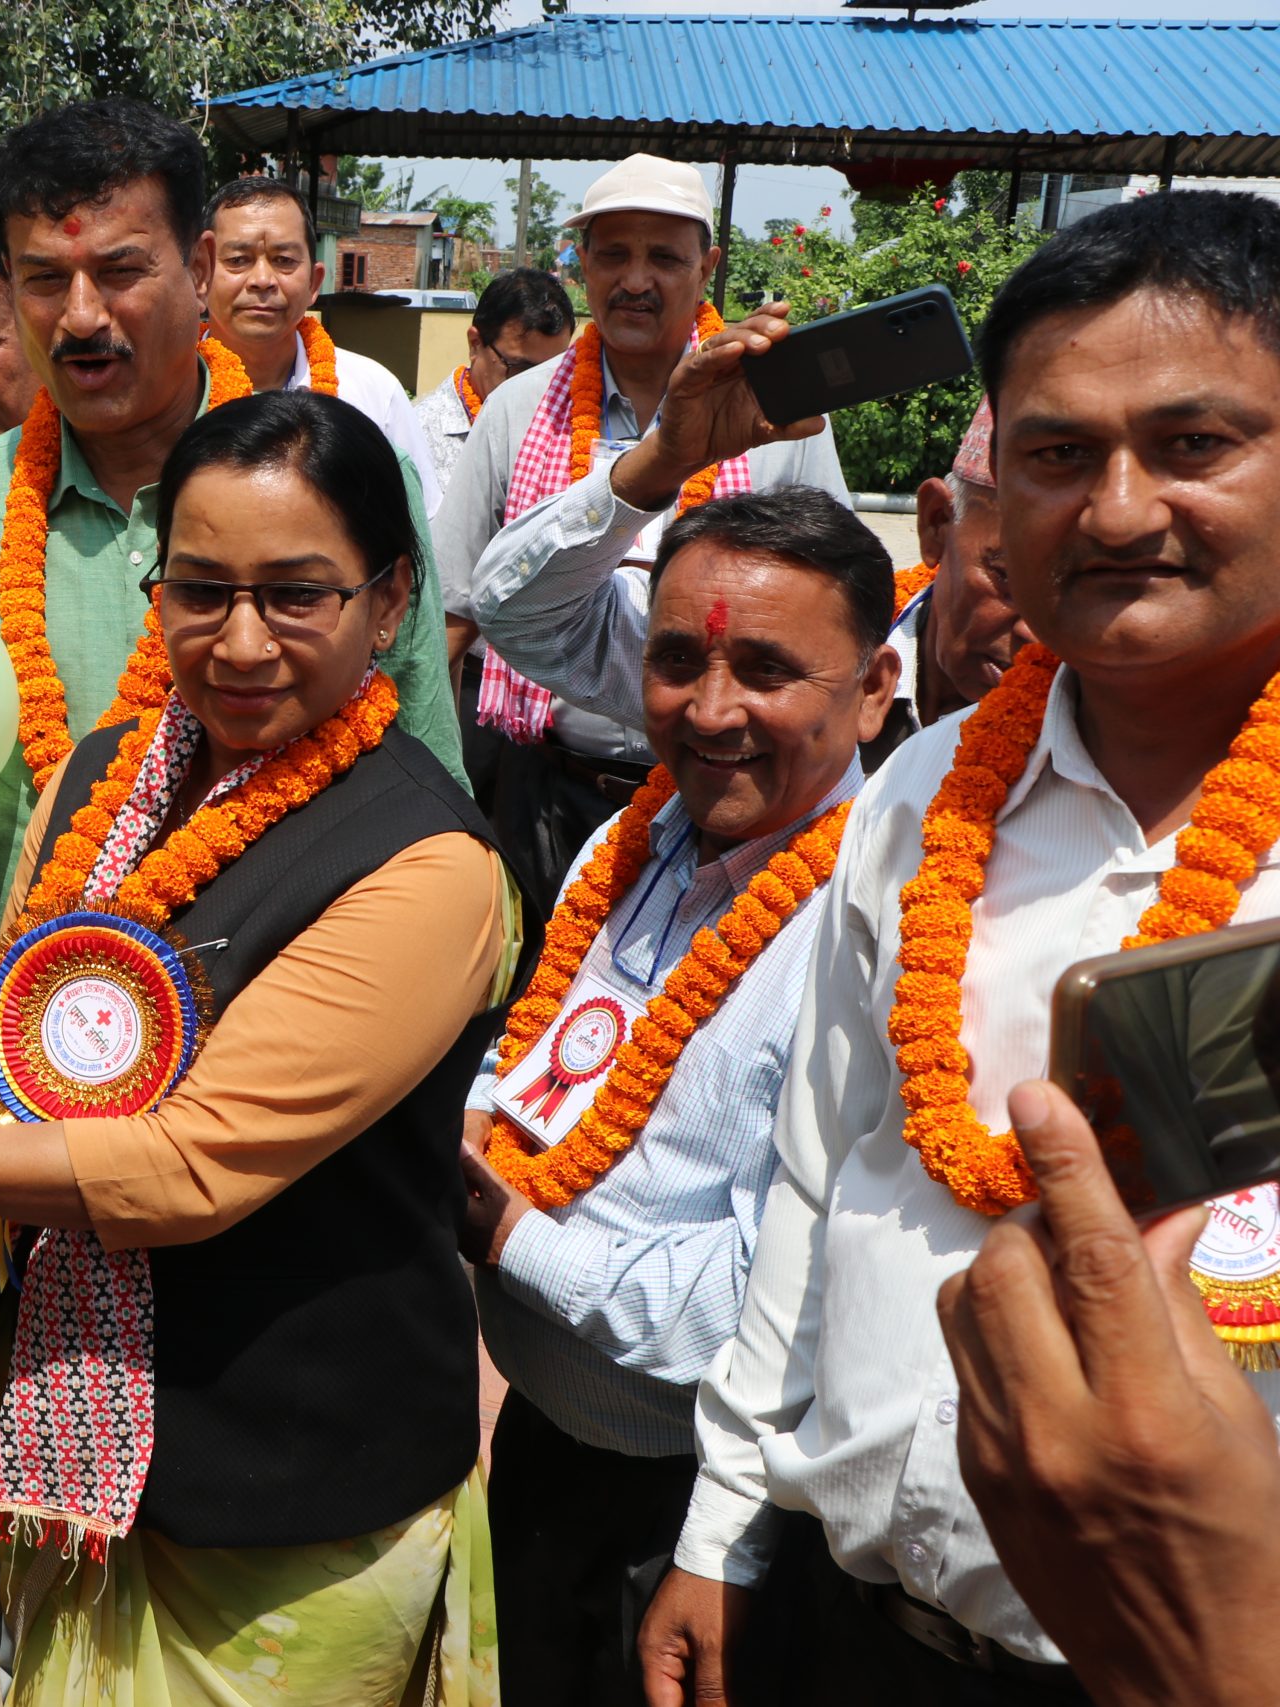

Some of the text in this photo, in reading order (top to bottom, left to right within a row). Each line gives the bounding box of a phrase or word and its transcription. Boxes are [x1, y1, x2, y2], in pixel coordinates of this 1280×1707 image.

[67, 1004, 89, 1031] प्रमुख
[84, 1027, 110, 1056] अतिथि
[1207, 1199, 1264, 1246] भापति
